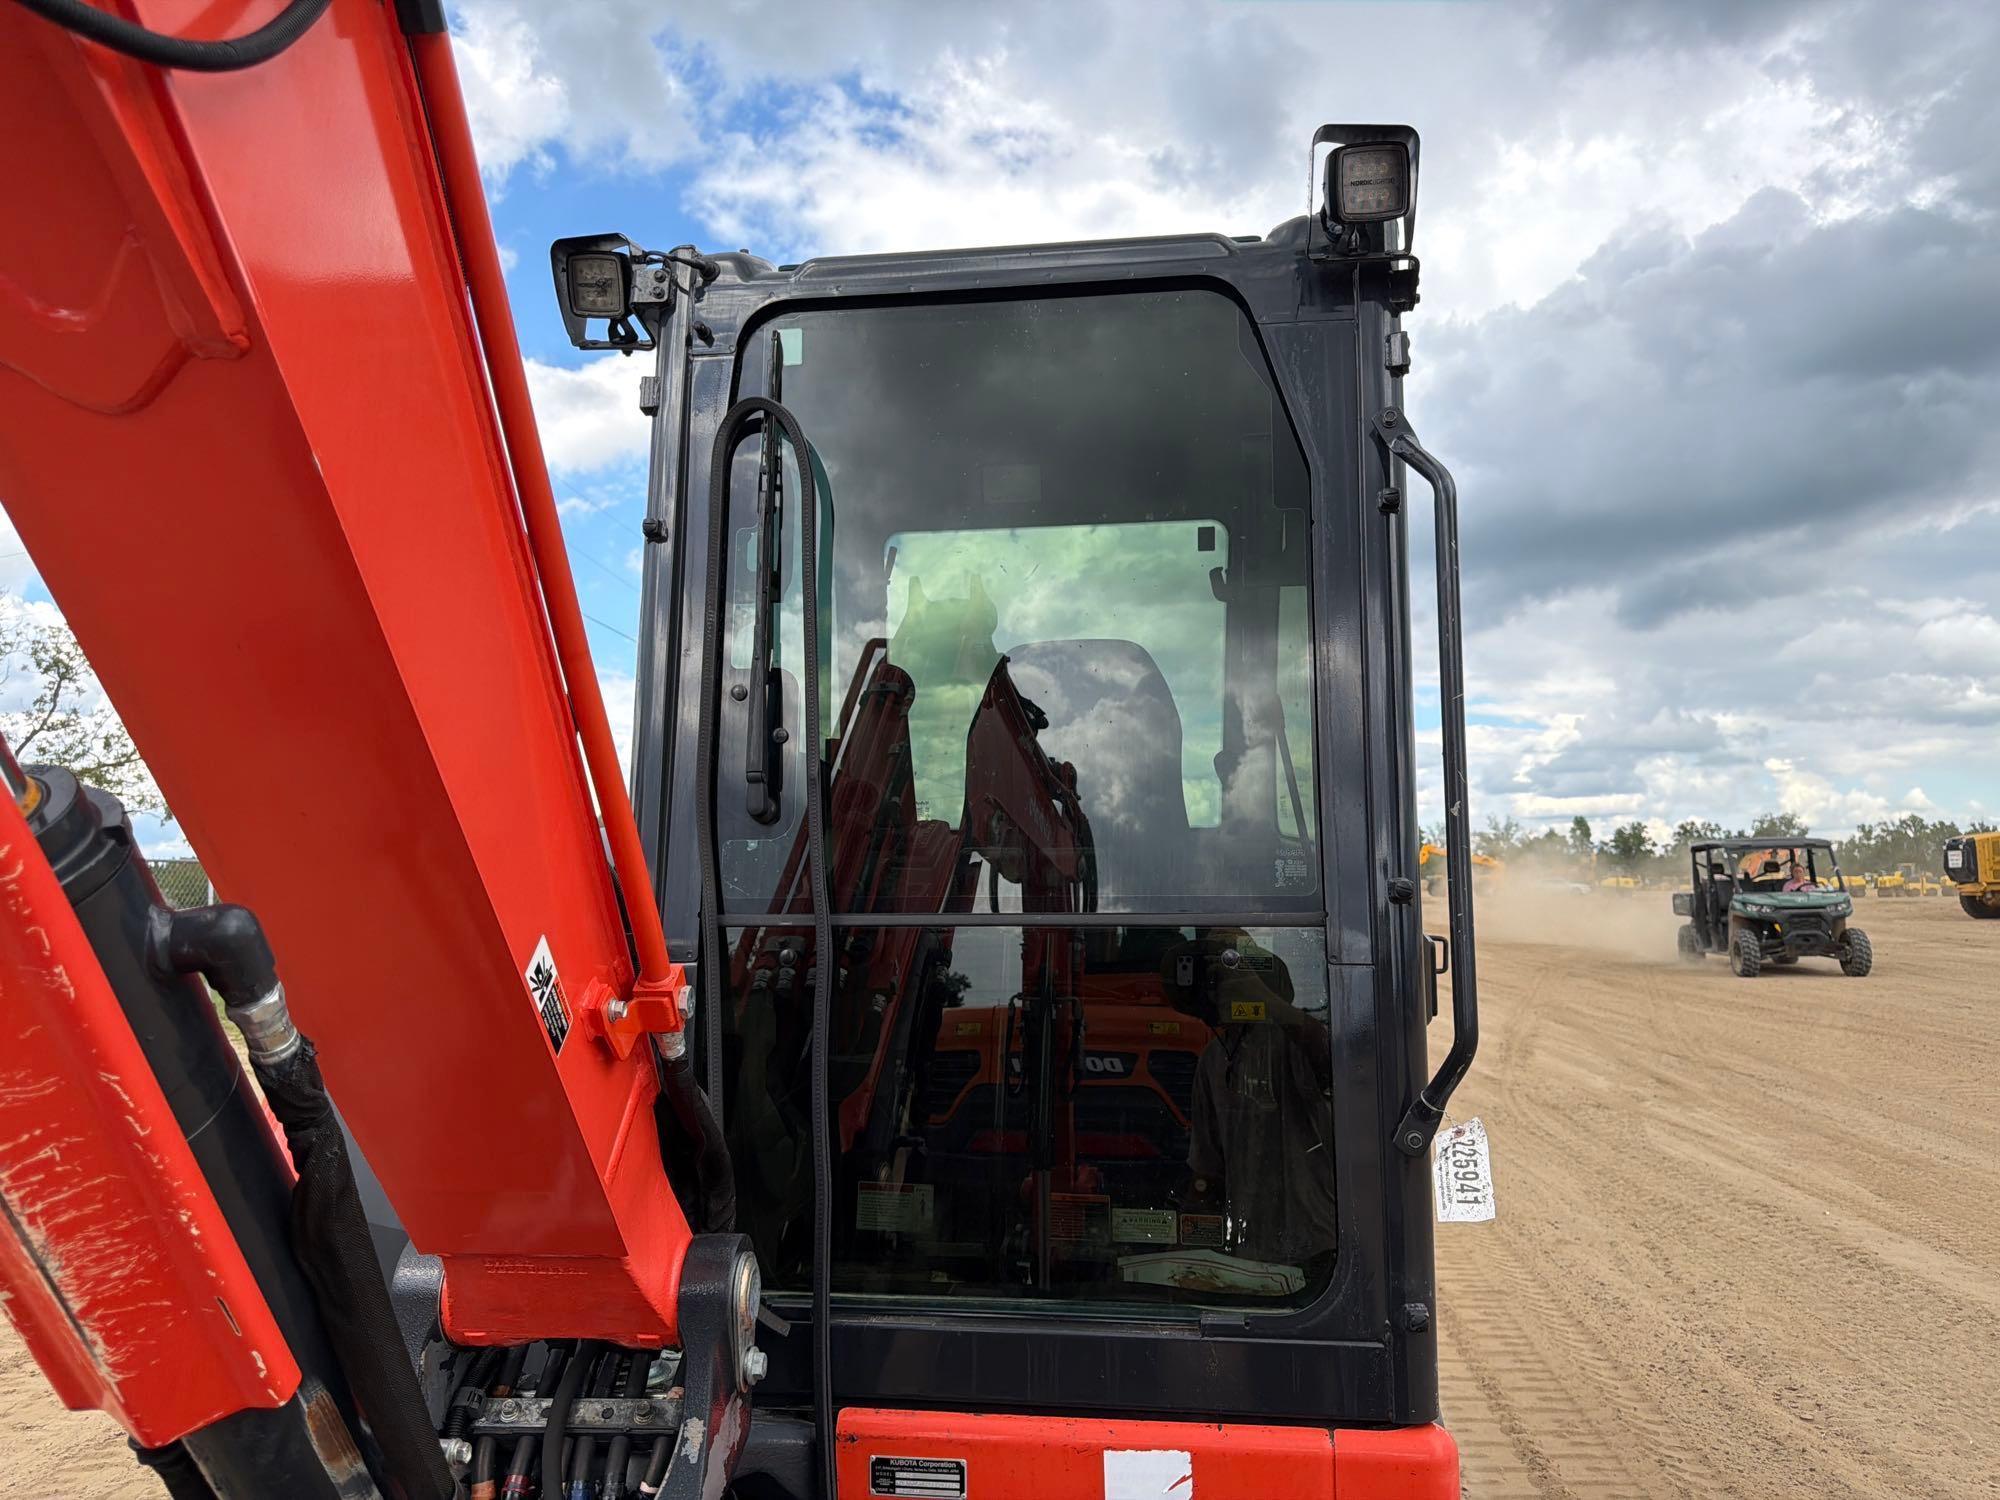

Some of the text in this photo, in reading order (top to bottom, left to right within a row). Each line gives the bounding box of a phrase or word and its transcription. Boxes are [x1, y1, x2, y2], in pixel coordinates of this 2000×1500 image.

[1451, 1139, 1483, 1205] 225941
[889, 1459, 957, 1468] KUBOTA Corporation
